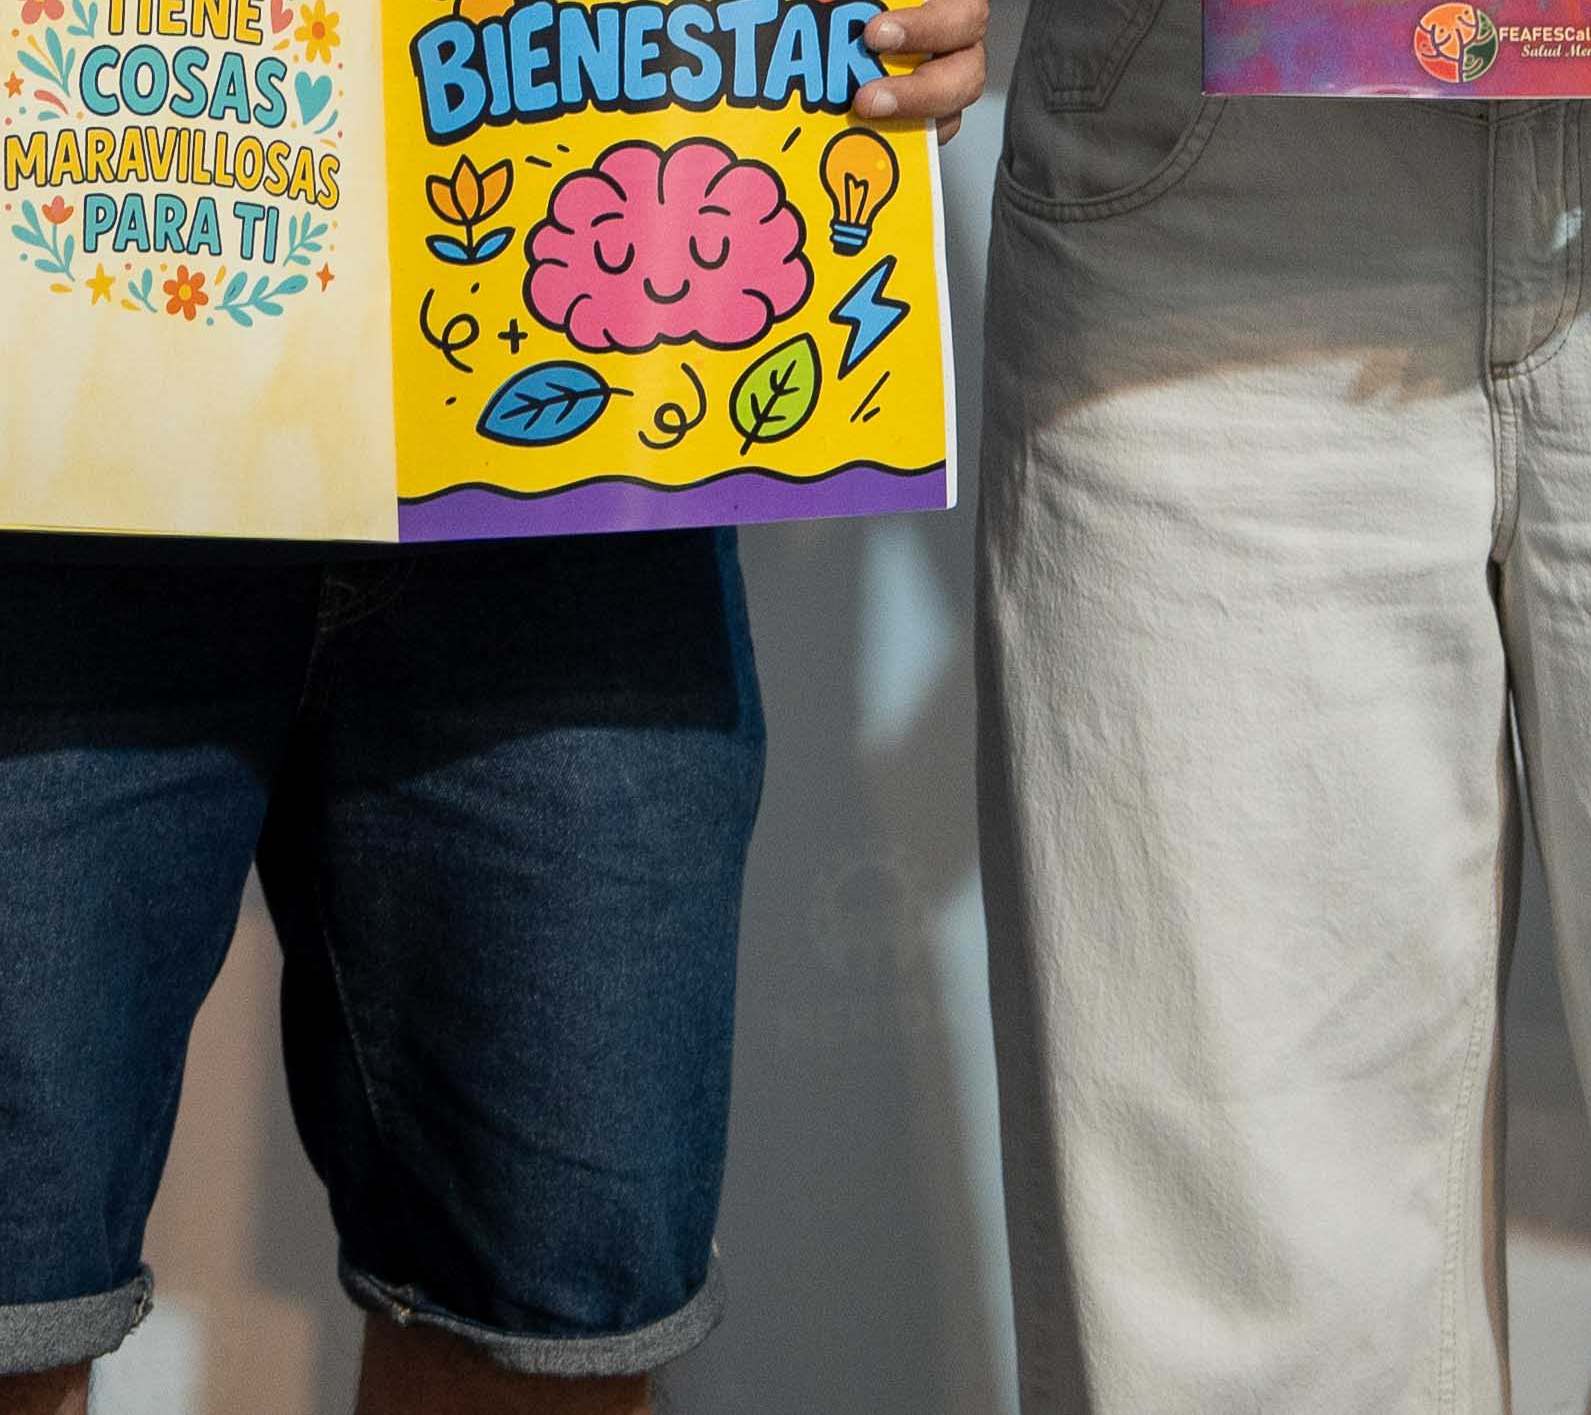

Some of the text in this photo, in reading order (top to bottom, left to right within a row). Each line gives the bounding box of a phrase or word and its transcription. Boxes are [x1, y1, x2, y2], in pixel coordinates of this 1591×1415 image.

[79, 44, 288, 128] COSAS
[1521, 43, 1562, 58] Salud
[4, 126, 340, 210] MARAVILLOSAS
[83, 193, 279, 263] PARA TI
